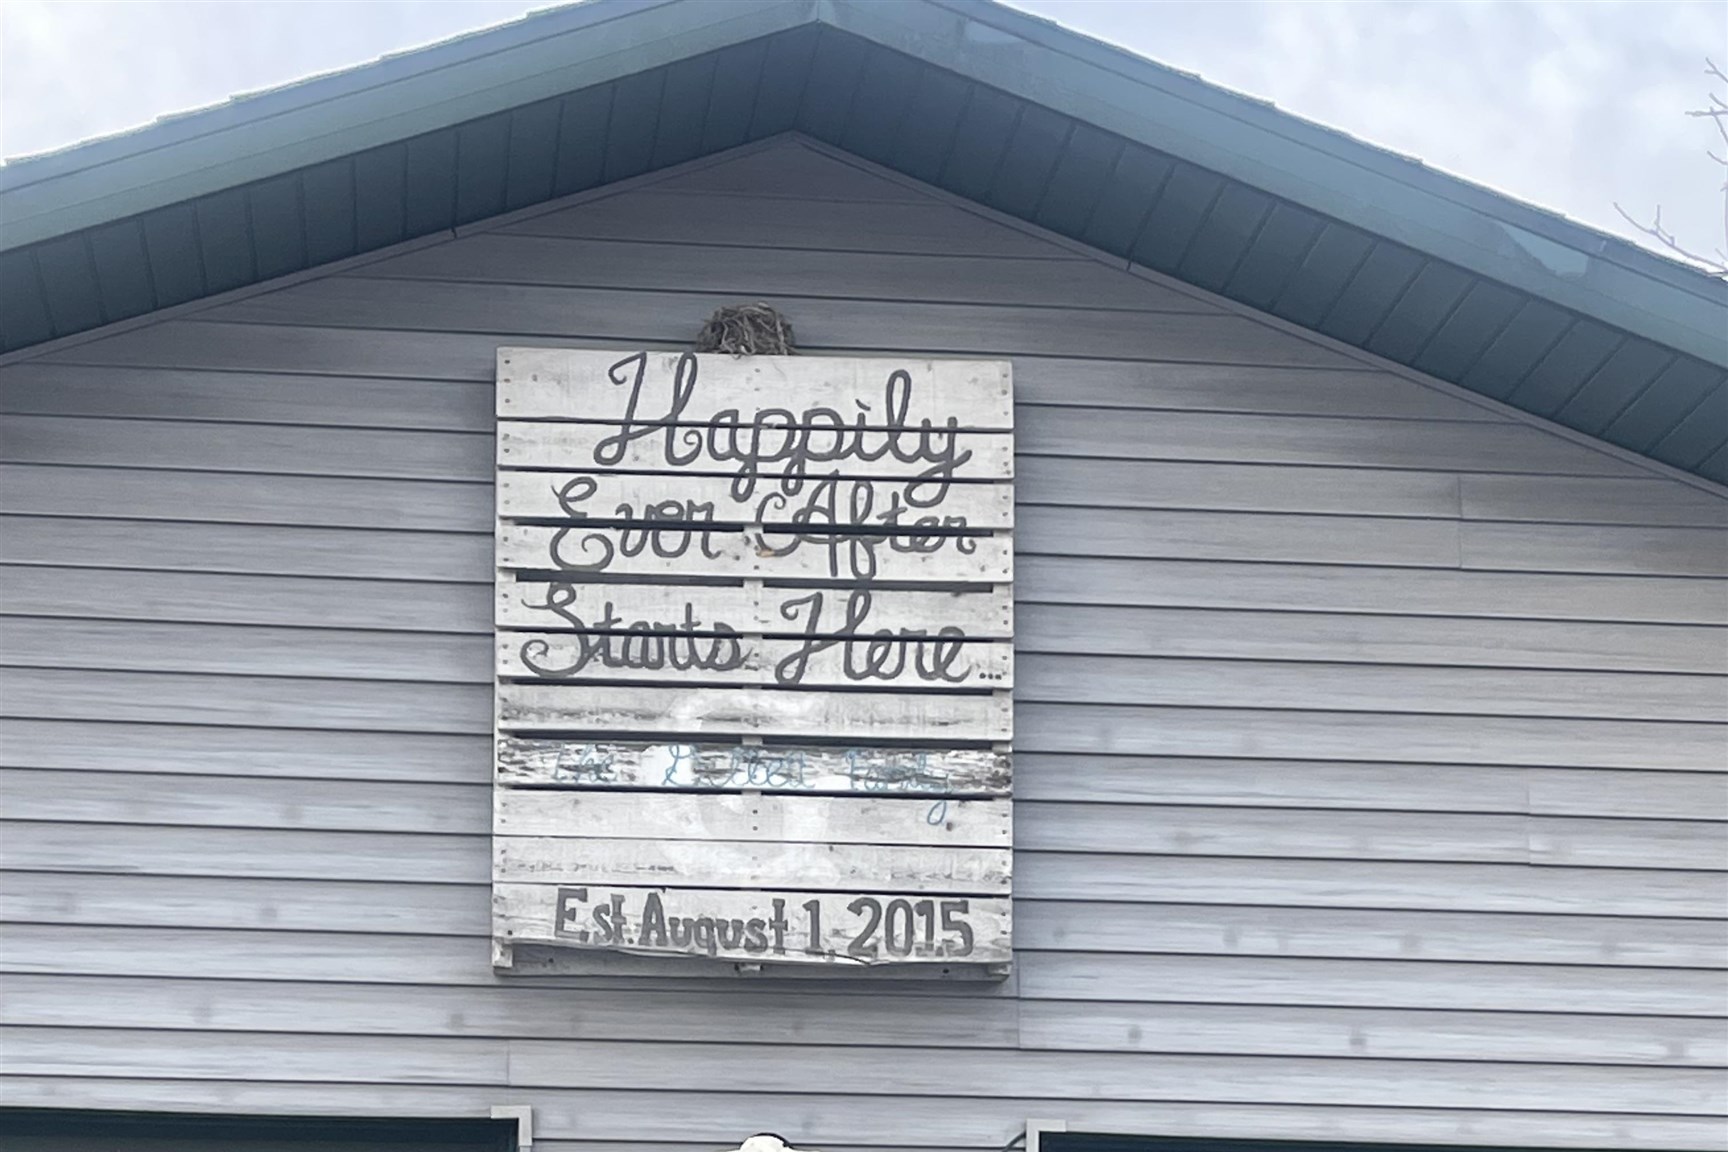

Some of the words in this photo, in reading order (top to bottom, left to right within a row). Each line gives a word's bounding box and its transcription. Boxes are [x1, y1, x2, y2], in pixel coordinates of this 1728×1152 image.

[592, 350, 973, 508] Happily
[550, 475, 722, 573] Ever
[754, 468, 979, 581] After
[519, 579, 754, 680] Starts
[637, 891, 789, 957] August
[846, 897, 975, 958] 2015
